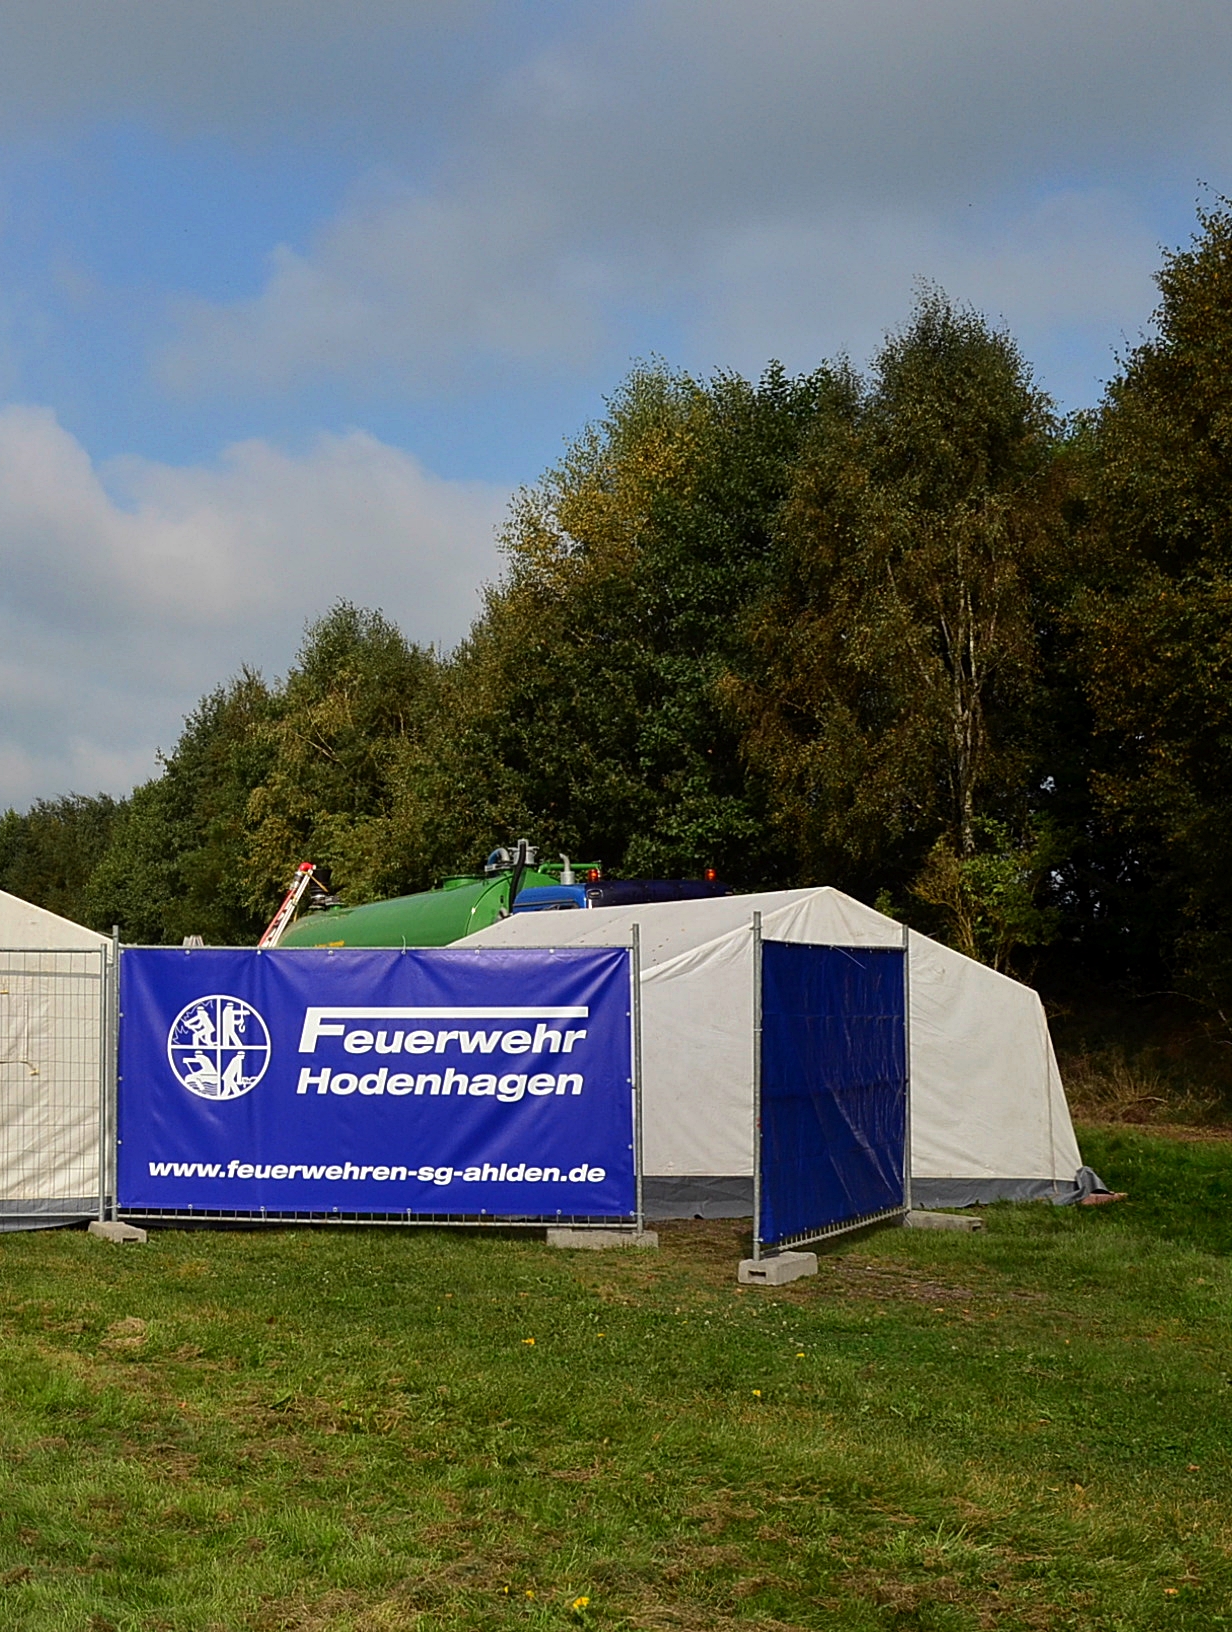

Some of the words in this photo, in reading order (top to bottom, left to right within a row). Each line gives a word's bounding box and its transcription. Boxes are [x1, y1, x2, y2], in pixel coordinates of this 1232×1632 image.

[298, 1006, 589, 1054] Feuerwehr
[296, 1067, 584, 1102] Hodenhagen
[148, 1160, 606, 1185] www.feuerwehren-sg-ahlden.de
